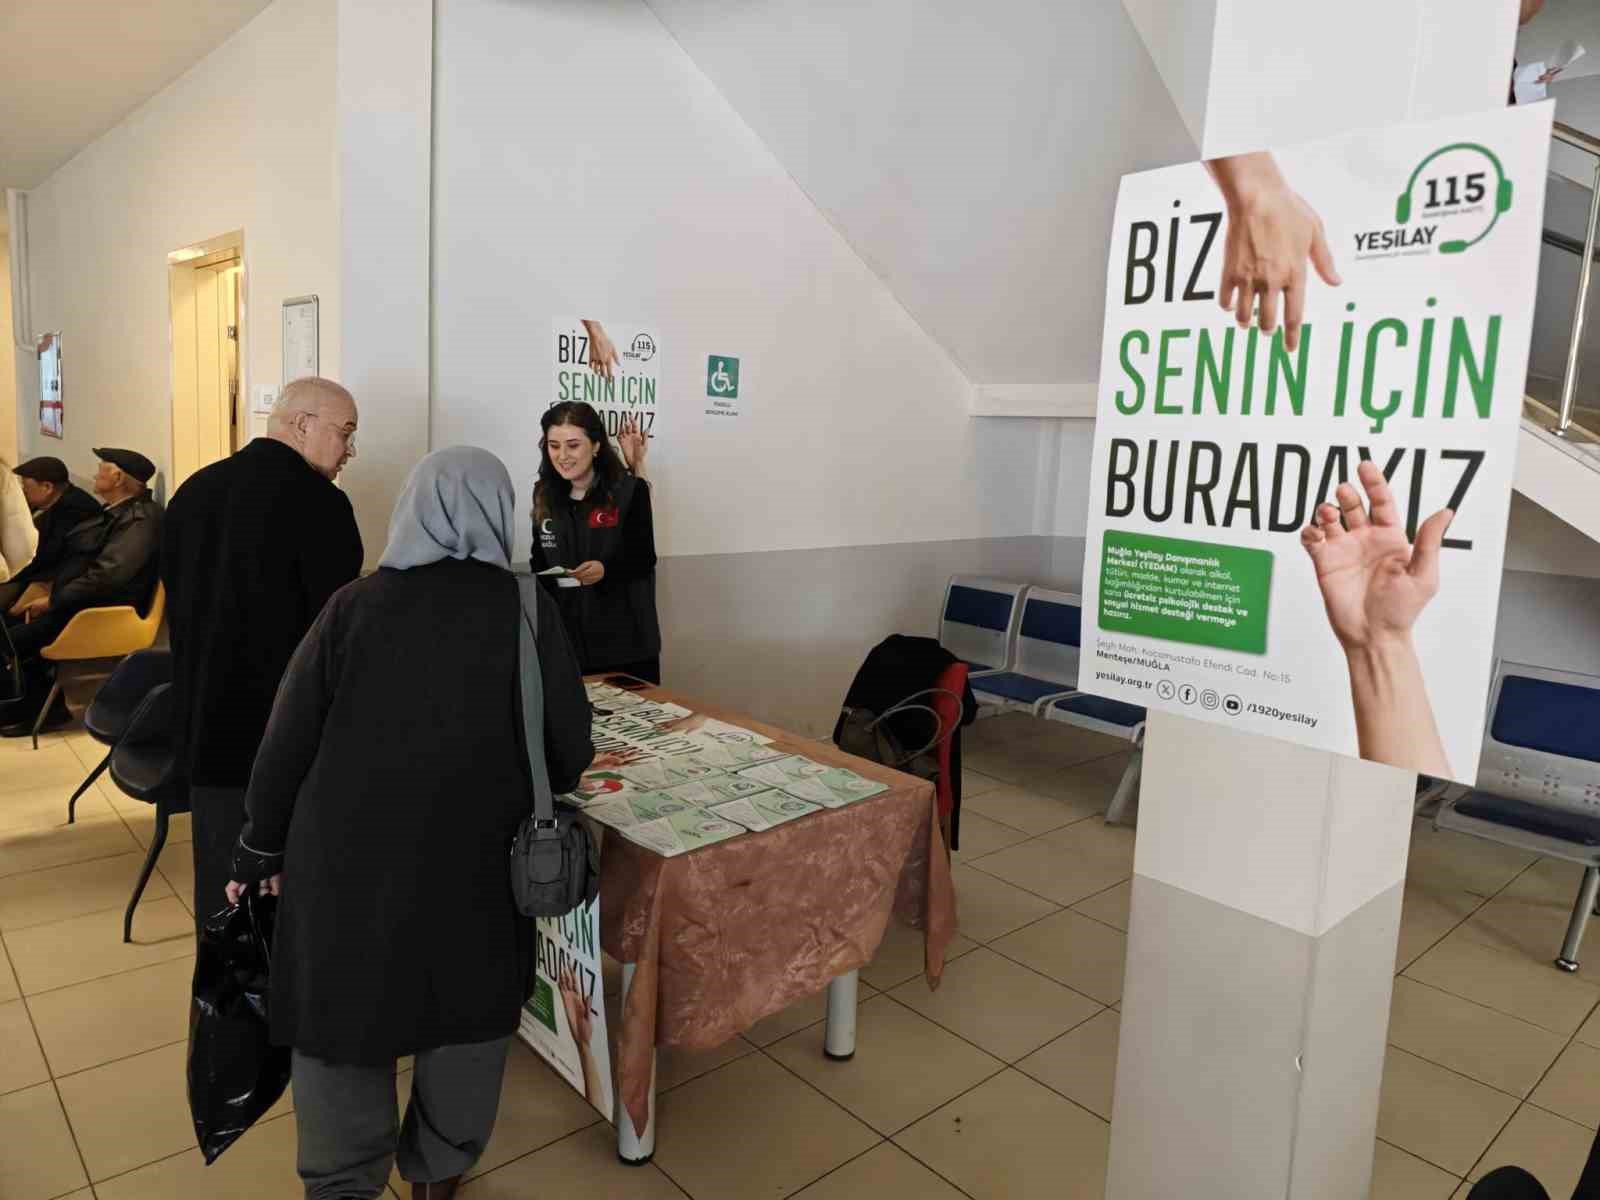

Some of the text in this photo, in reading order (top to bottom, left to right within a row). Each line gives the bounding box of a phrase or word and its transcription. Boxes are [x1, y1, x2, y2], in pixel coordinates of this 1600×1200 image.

[1424, 172, 1486, 209] 115
[1124, 199, 1223, 305] BİZ
[1354, 225, 1438, 251] YEŞİLAY
[558, 329, 588, 365] BİZ
[637, 340, 651, 350] 115
[1115, 296, 1502, 434] SENİN İÇİN
[558, 370, 656, 408] SENİN İÇİN
[1095, 671, 1153, 689] yesilay.org.tr
[1246, 702, 1319, 728] /1920yesilay
